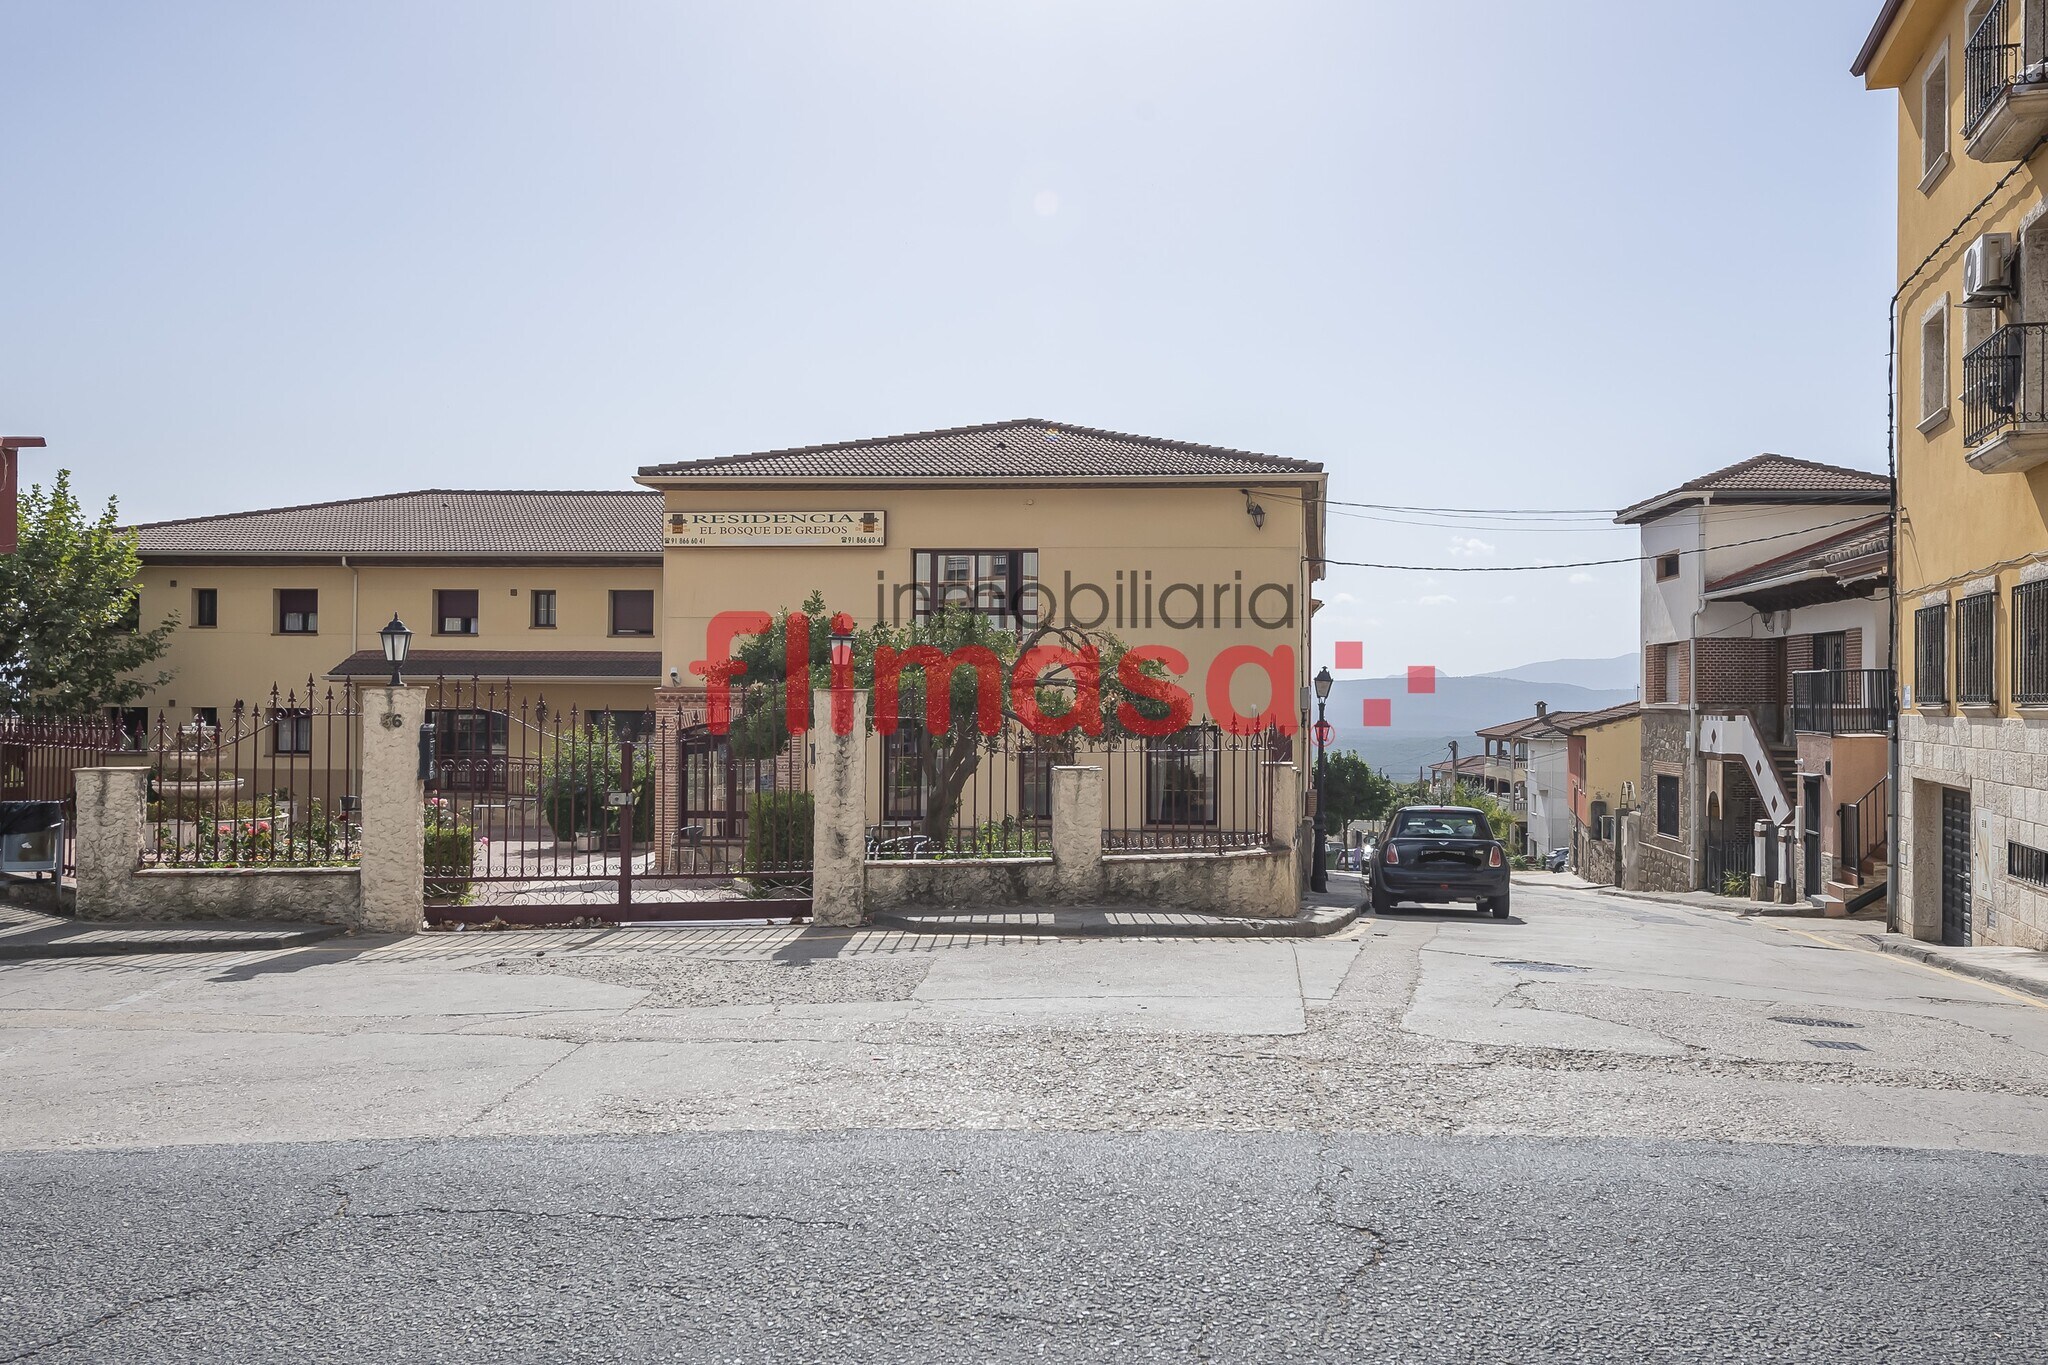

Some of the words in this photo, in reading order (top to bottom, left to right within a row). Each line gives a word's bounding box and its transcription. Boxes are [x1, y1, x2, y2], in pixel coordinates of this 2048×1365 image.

[692, 514, 854, 524] RESIDENCIA
[700, 526, 717, 535] EL
[719, 526, 771, 536] BOSQUE
[774, 526, 793, 535] DE
[795, 526, 848, 535] GREDOS
